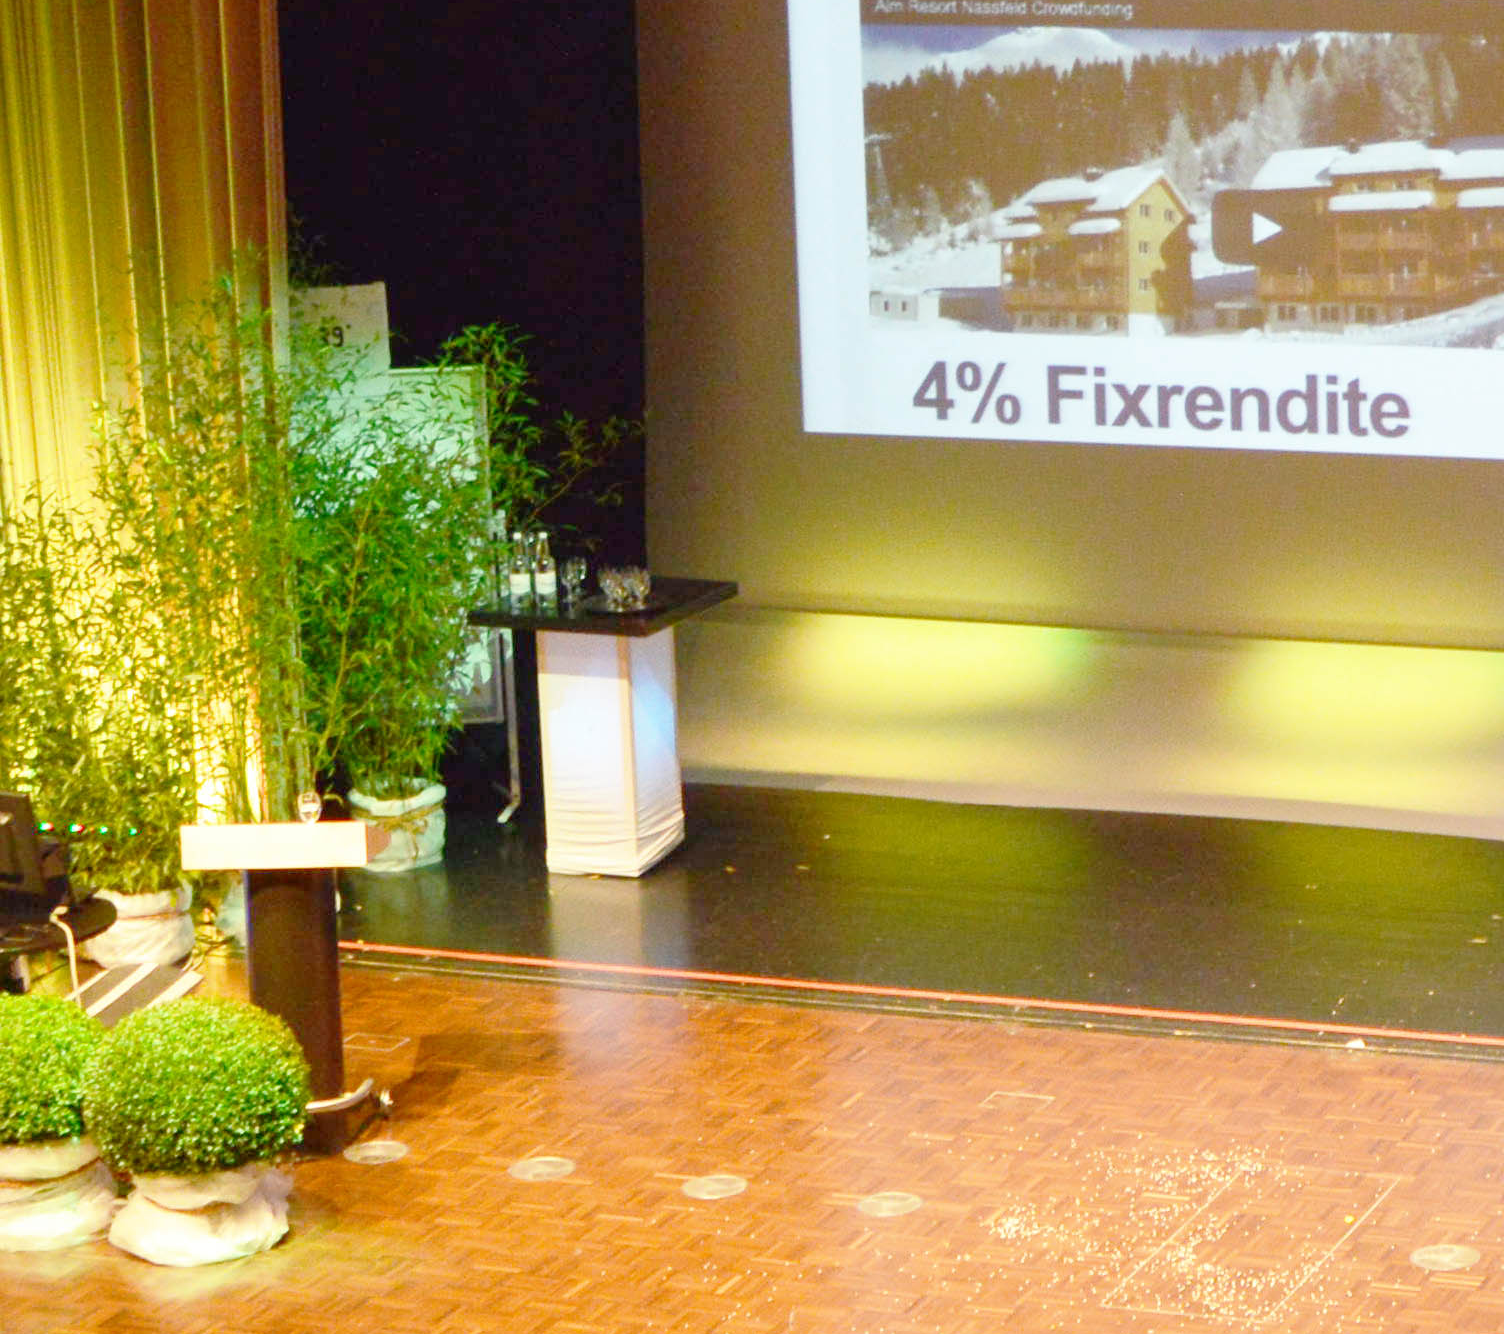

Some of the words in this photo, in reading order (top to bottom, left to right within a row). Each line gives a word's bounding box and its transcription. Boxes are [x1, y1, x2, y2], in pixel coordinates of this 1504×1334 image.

[962, 0, 1026, 16] Nassfeld
[1031, 0, 1134, 20] Crowdfunding
[912, 361, 1022, 425] 4%
[1046, 364, 1410, 439] Fixrendite
